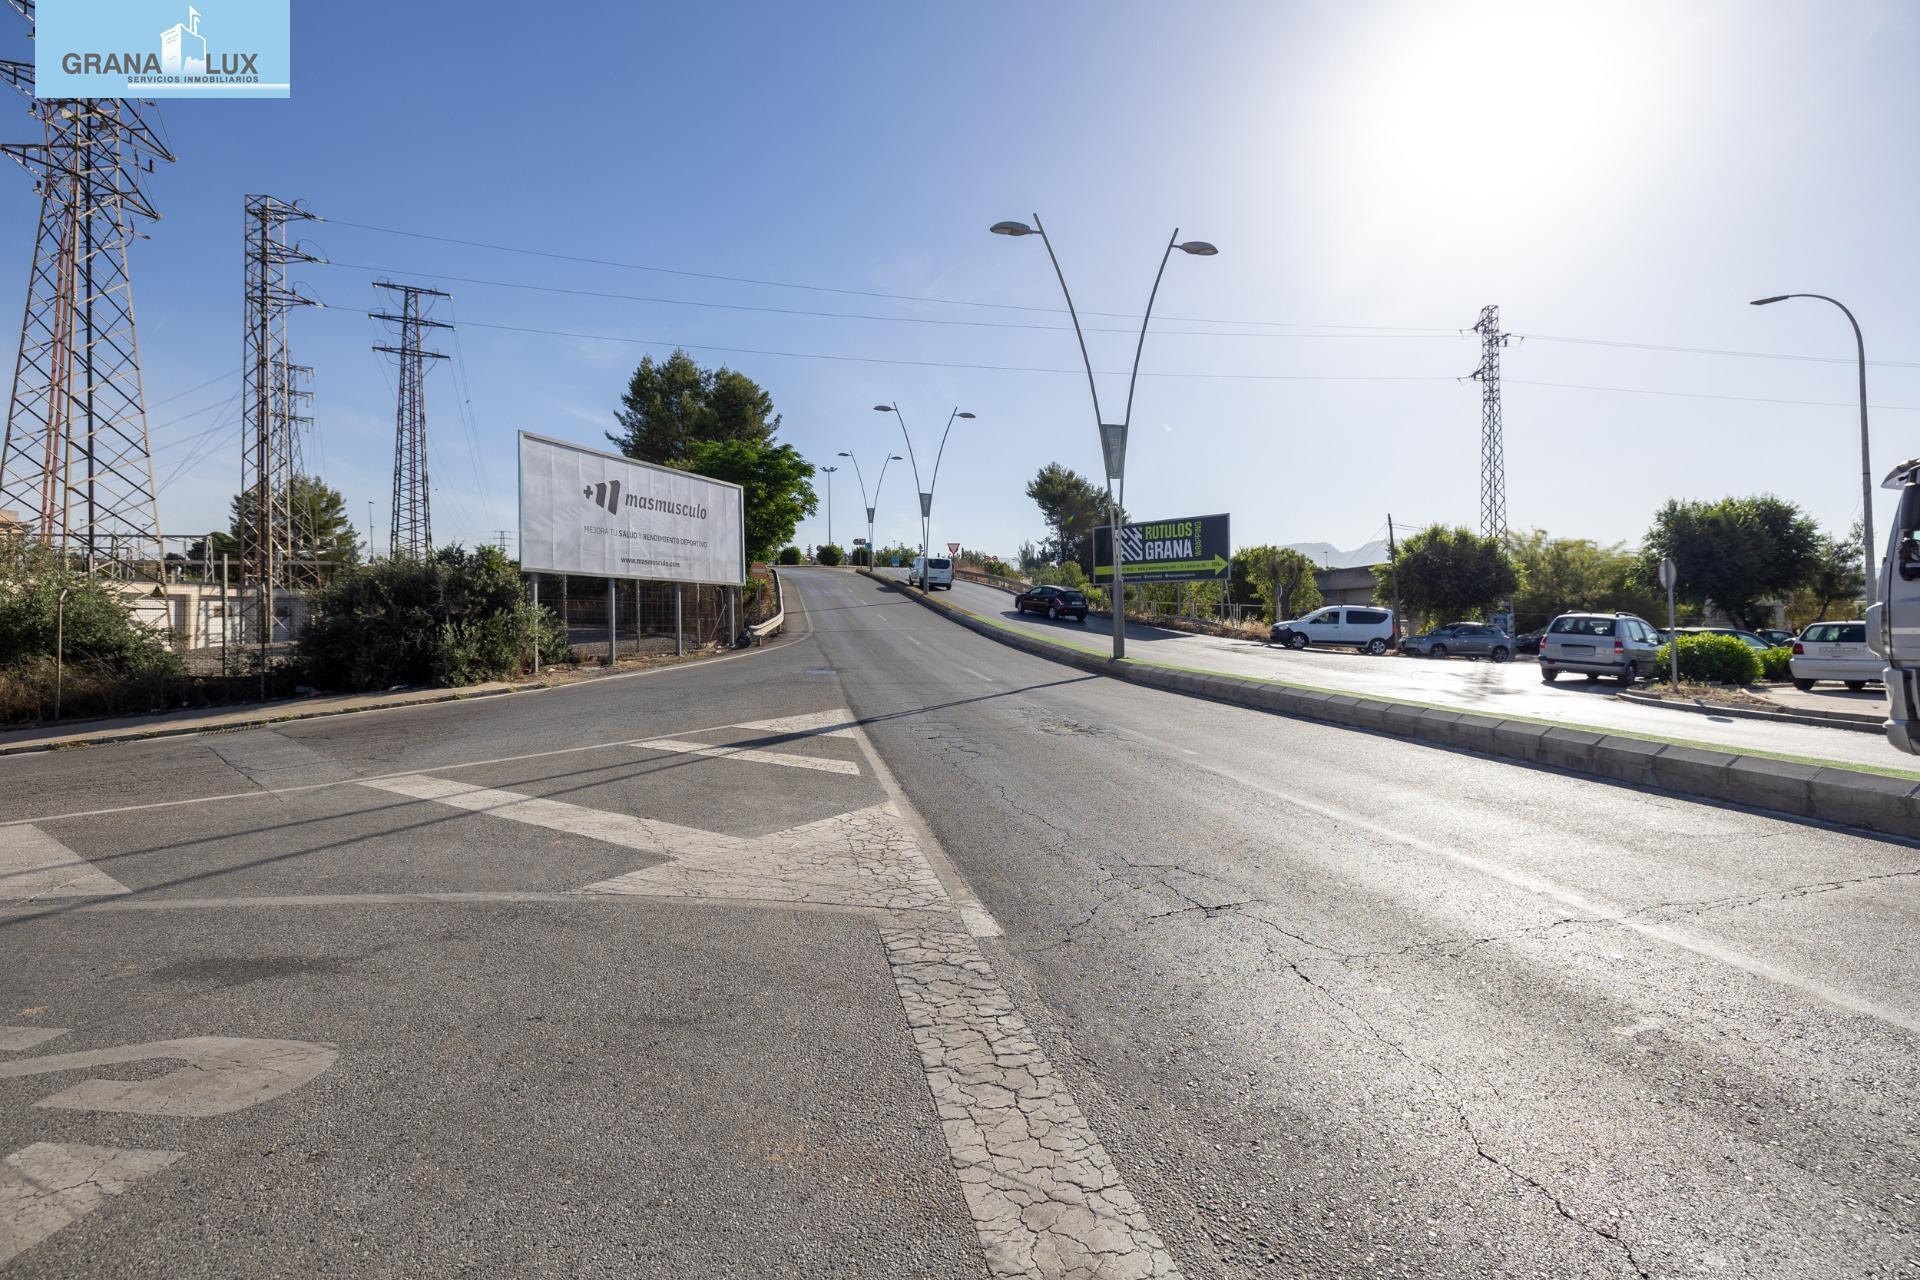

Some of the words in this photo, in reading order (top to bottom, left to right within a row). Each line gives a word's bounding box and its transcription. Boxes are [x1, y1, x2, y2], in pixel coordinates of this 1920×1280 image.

[625, 492, 707, 520] masmusculo
[583, 525, 609, 535] MEJORA
[610, 528, 618, 537] TU
[618, 529, 638, 540] SALUD
[642, 533, 680, 545] RENDIMIENTO
[680, 538, 709, 549] DEPORTIVO
